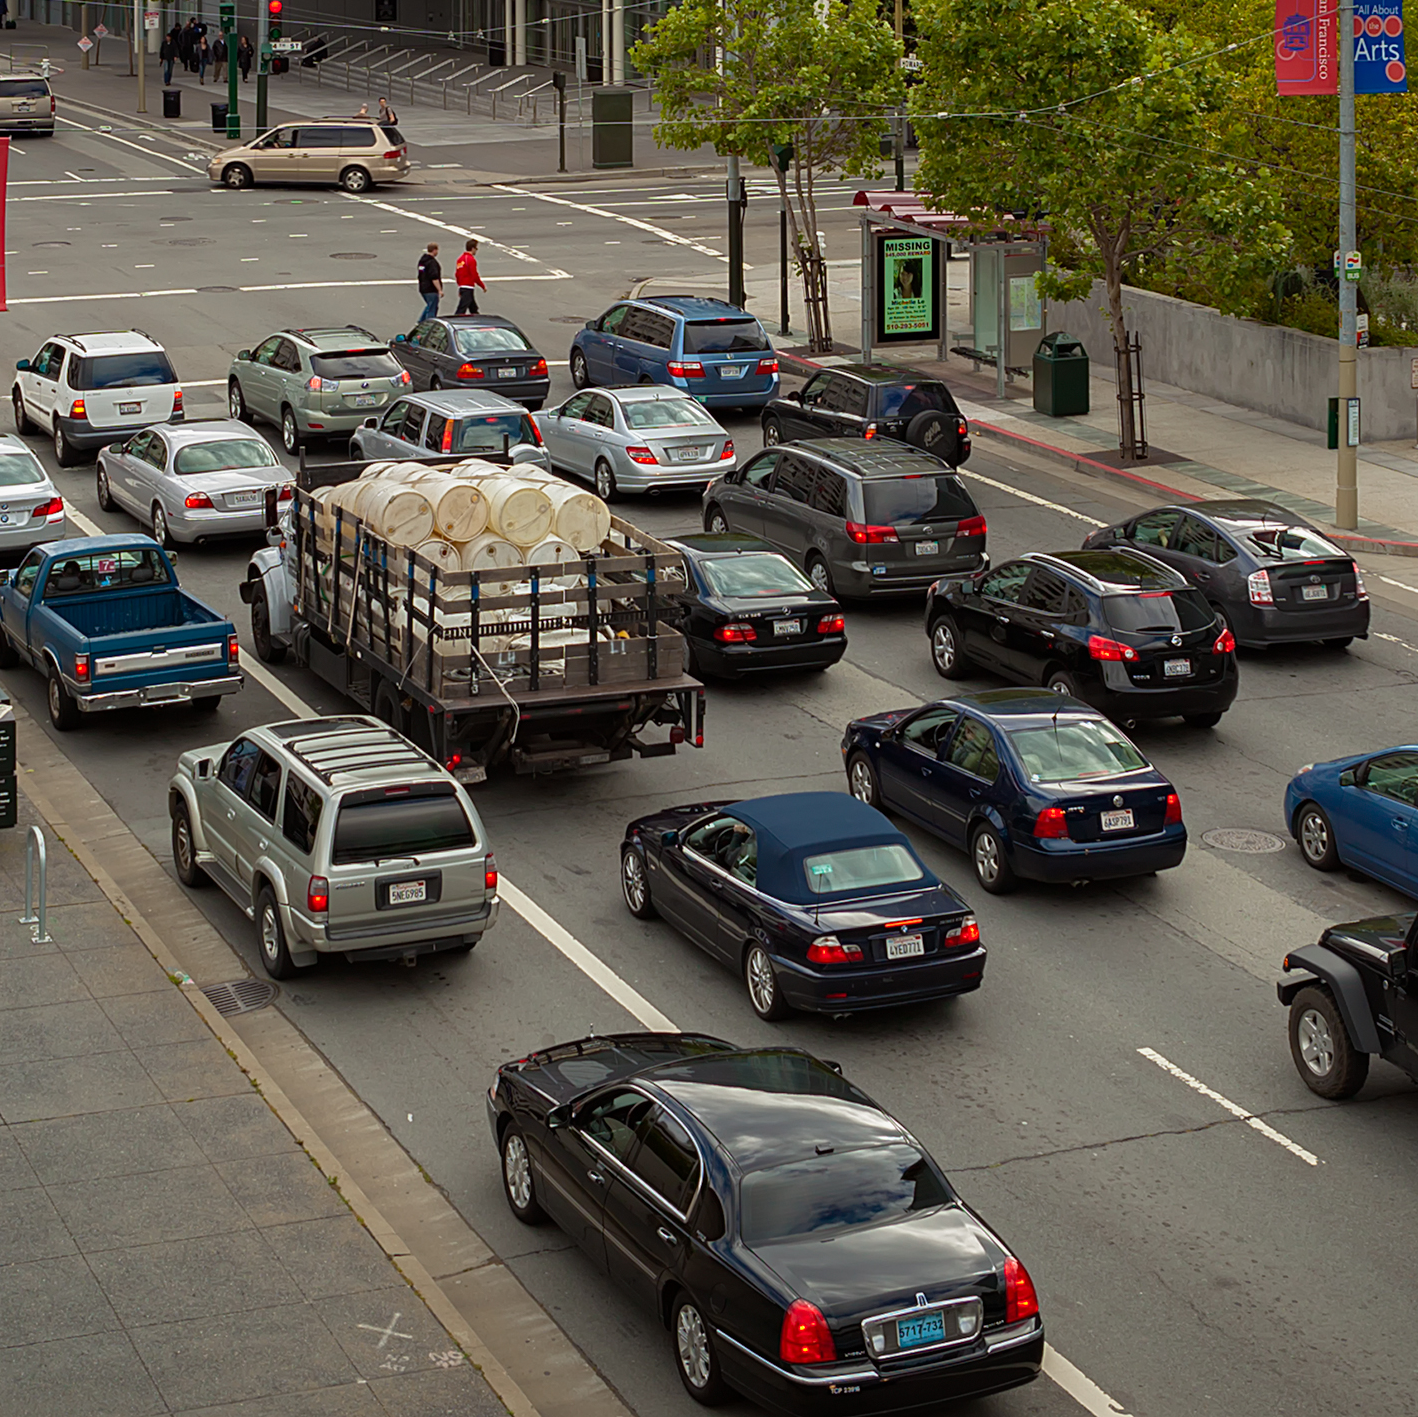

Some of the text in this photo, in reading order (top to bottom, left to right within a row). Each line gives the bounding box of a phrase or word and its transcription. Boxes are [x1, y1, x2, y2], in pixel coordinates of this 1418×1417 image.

[1358, 4, 1399, 15] All About
[1369, 22, 1379, 30] the
[1318, 18, 1330, 80] Francisco
[1354, 38, 1400, 61] Arts
[885, 241, 931, 252] MISSING
[392, 887, 424, 902] 5NEG985
[889, 940, 922, 955] 4YED771
[899, 1319, 943, 1339] 5717-732
